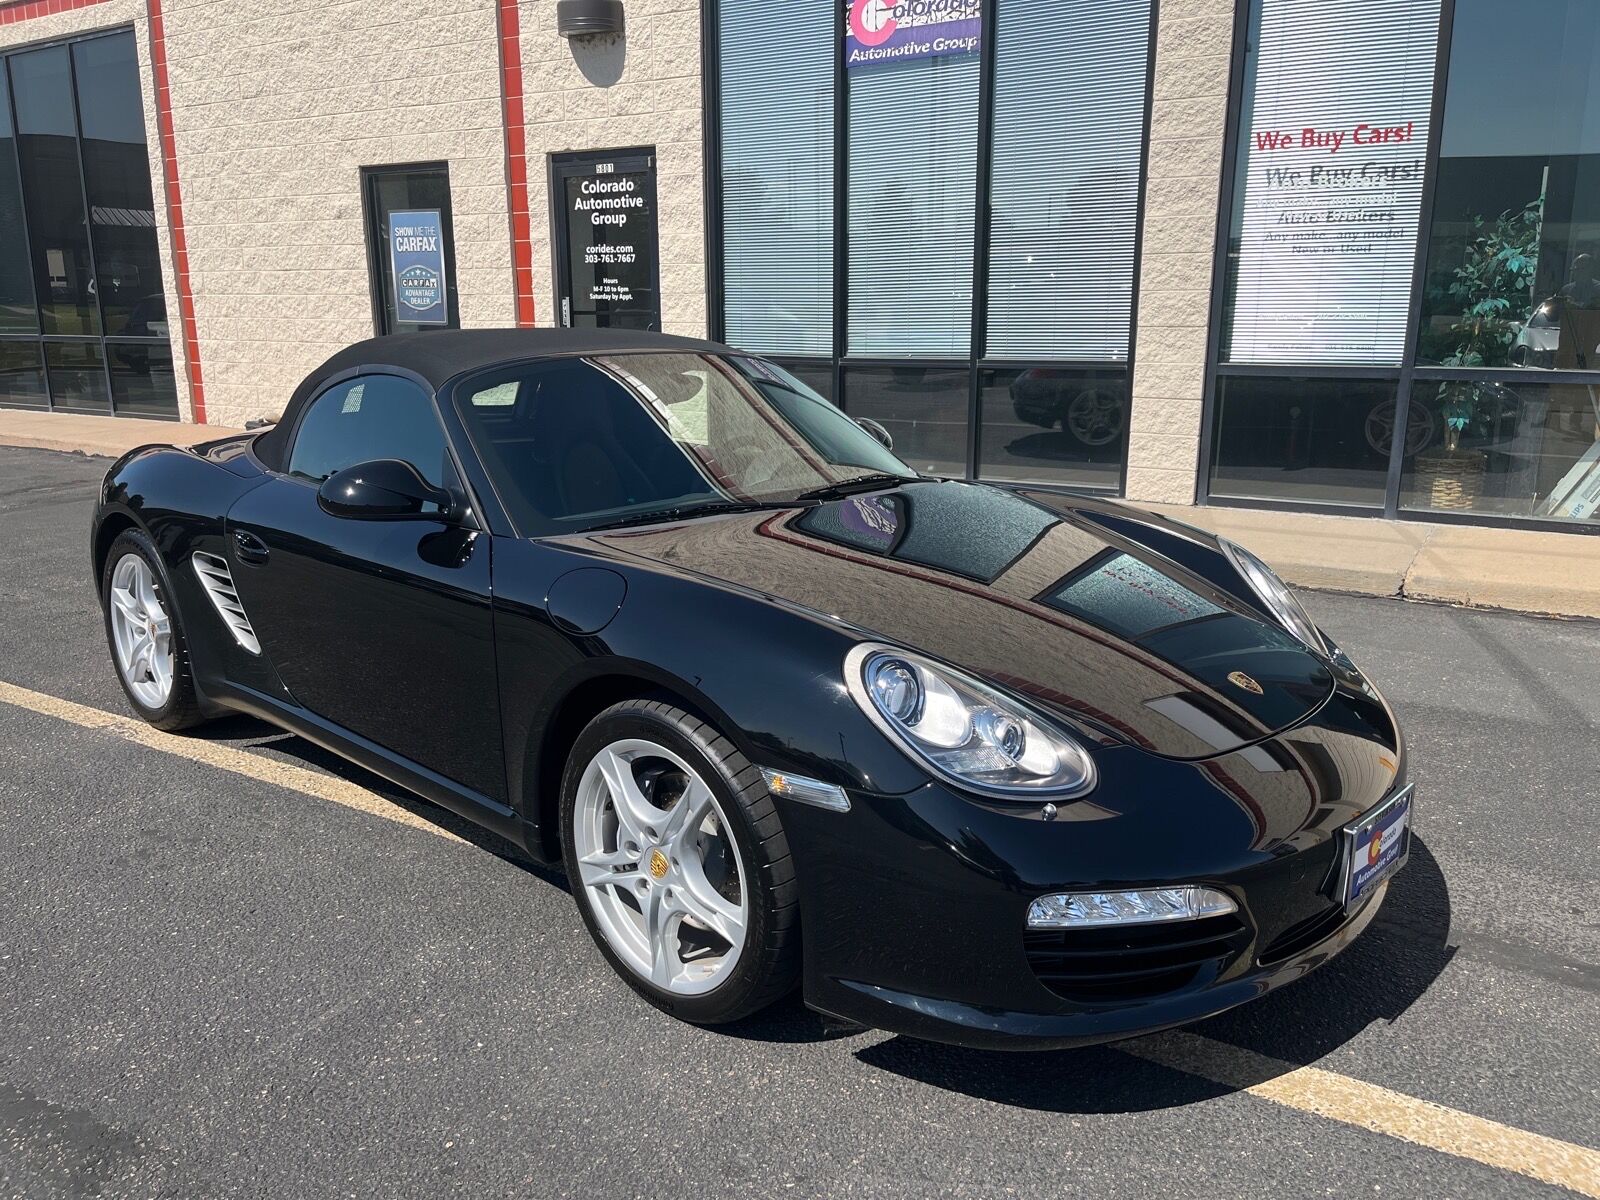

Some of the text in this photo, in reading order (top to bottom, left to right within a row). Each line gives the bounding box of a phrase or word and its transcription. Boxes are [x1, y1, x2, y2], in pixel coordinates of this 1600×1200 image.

[849, 36, 977, 62] Automotive Group
[1256, 121, 1414, 154] We Buy Cars!
[581, 178, 634, 194] Colorado
[574, 194, 643, 210] Automotive
[591, 212, 627, 227] Group
[395, 226, 436, 237] SHOW ME THE
[396, 237, 437, 252] CARFAX
[586, 244, 633, 254] corides.com
[584, 254, 636, 264] 303-761-7667
[402, 279, 437, 288] CARFAX
[405, 289, 435, 297] ADVANTAGE
[590, 293, 633, 301] Saturday by Appt.
[410, 297, 430, 305] DEALER
[1356, 857, 1386, 887] Automotive
